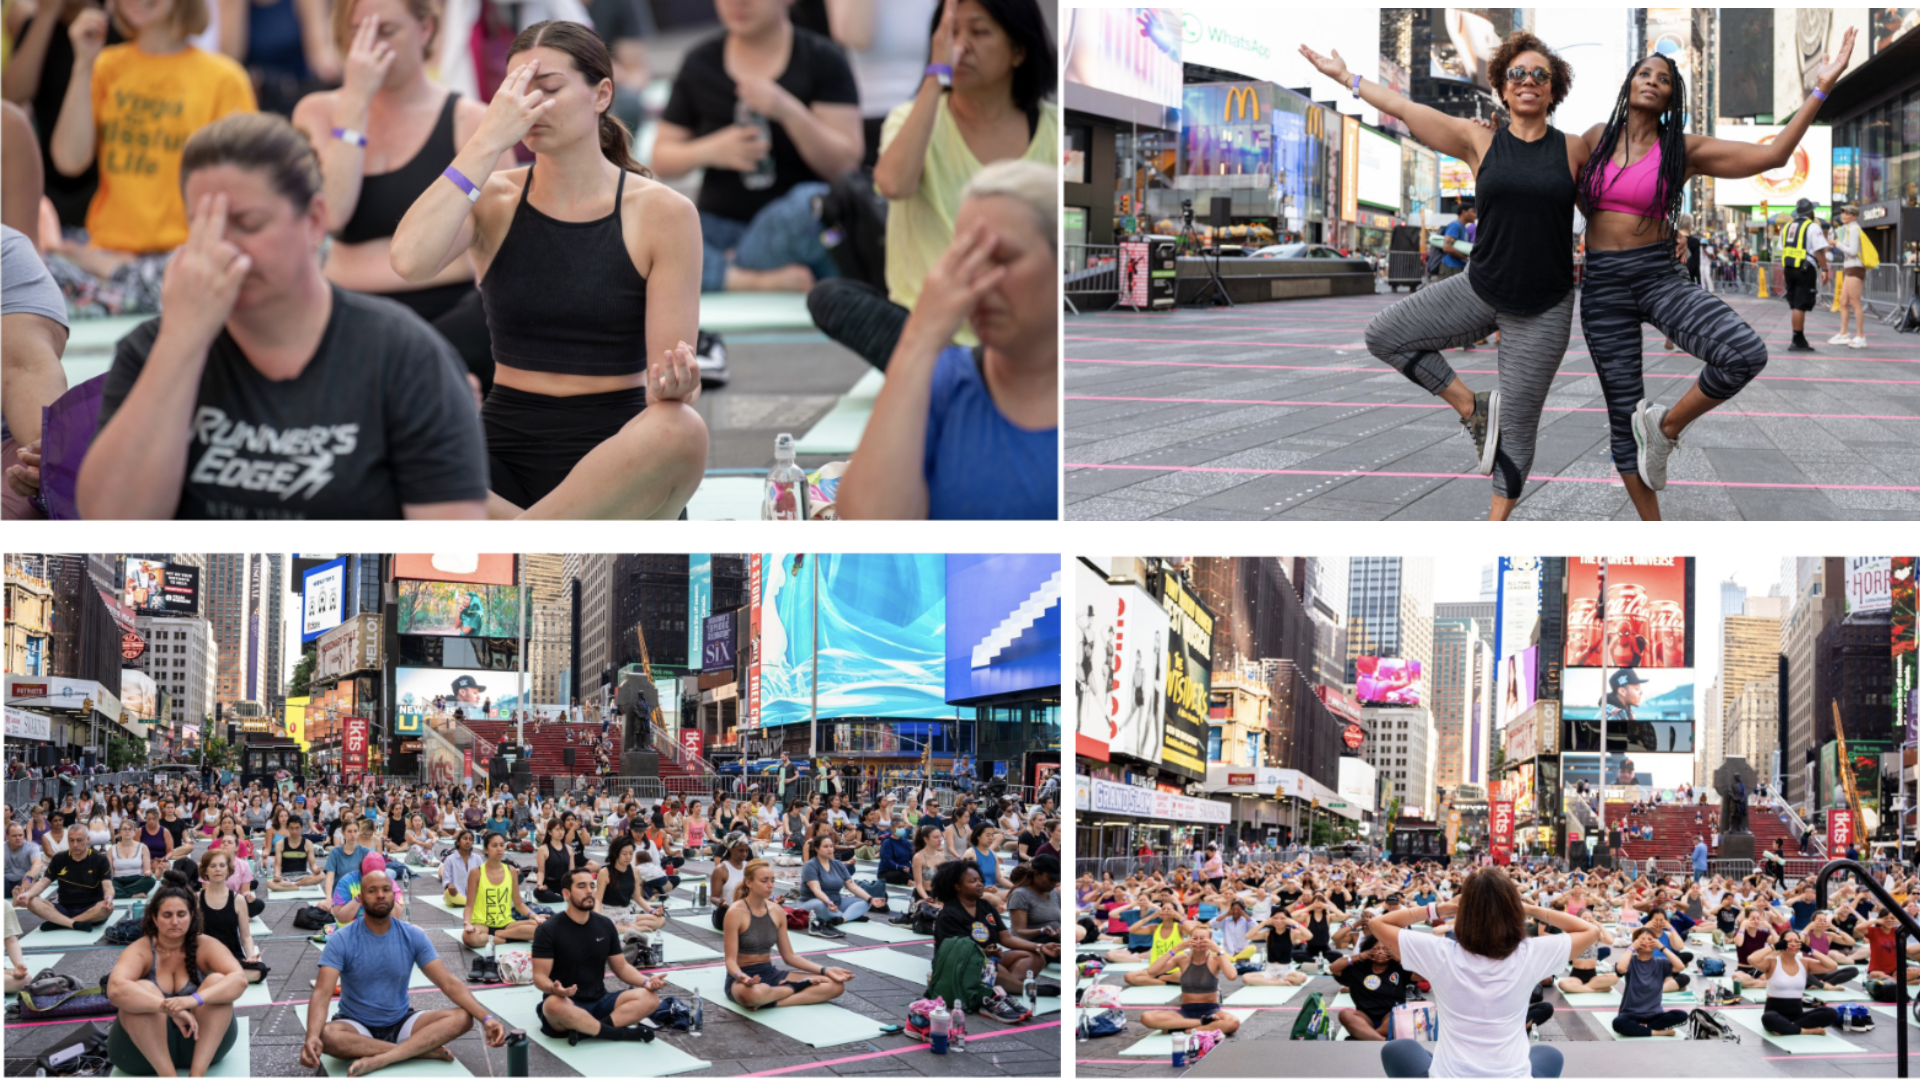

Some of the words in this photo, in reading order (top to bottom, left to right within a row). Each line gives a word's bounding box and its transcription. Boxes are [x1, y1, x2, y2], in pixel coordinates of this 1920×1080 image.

[1207, 25, 1271, 59] WhatsApp
[116, 89, 183, 121] Yoga
[106, 150, 158, 175] Life
[1863, 207, 1885, 221] swatch
[189, 405, 360, 455] RUNNER'S
[190, 445, 299, 492] EDGE
[205, 501, 246, 520] NEW
[752, 570, 760, 611] STORE
[366, 616, 378, 667] HELLO!
[750, 676, 759, 704] FREE
[399, 705, 425, 714] NEW
[349, 720, 365, 751] tkts
[1543, 704, 1555, 752] HELLO!
[685, 731, 699, 761] tkts
[1496, 803, 1511, 834] tkts
[1834, 811, 1851, 844] tkts
